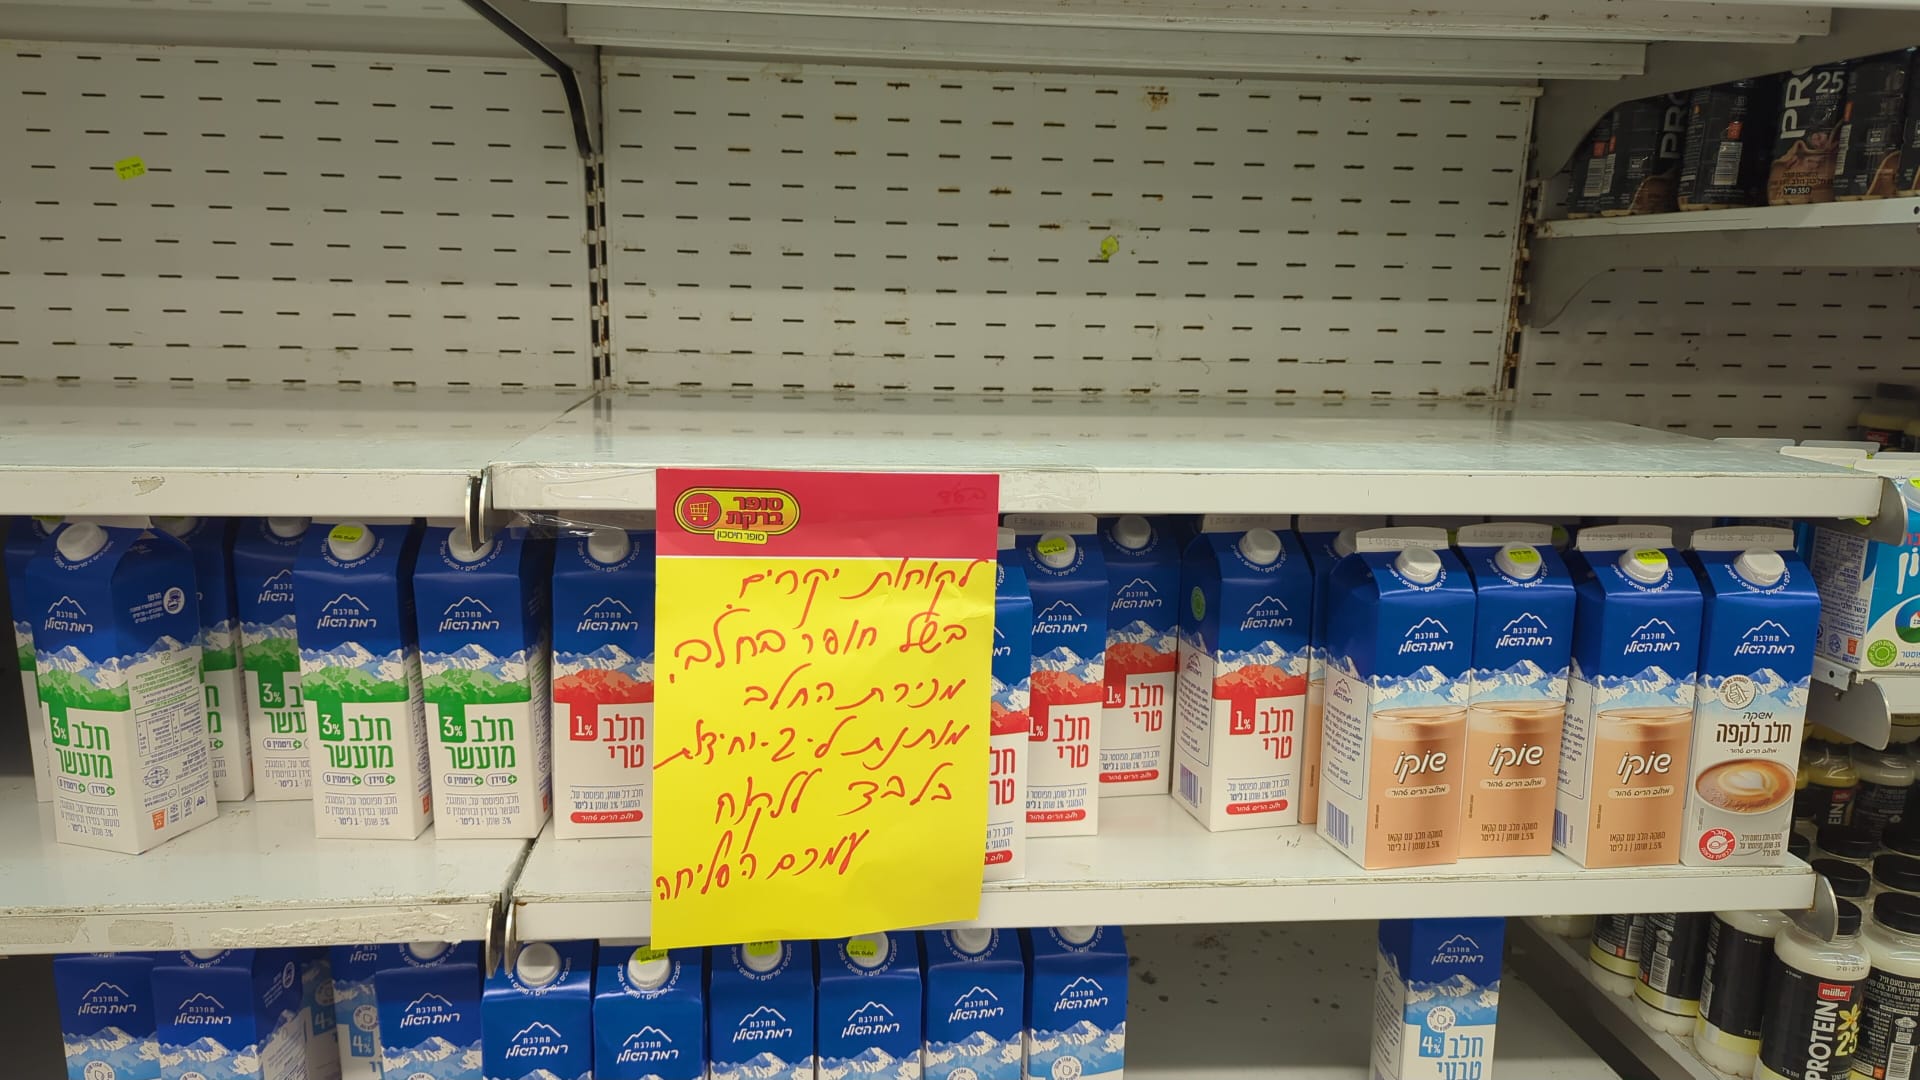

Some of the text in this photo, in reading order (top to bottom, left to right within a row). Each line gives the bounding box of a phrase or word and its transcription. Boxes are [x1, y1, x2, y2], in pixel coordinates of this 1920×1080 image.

[1816, 71, 1844, 94] 25
[733, 497, 783, 511] סופר
[726, 511, 784, 530] ברקת
[744, 533, 765, 542] סופר
[839, 556, 989, 622] לקוחות
[349, 617, 377, 628] רמת
[472, 620, 500, 631] רמת
[611, 621, 639, 631] רמת
[900, 612, 967, 654] בשל
[1061, 623, 1088, 633] רמת
[801, 620, 877, 655] חוסר
[1428, 641, 1454, 652] רמת
[1525, 636, 1553, 646] רמת
[1654, 642, 1680, 653] רמת
[1766, 645, 1795, 655] רמת
[261, 683, 281, 703] 3%
[743, 663, 834, 710] החלב
[1106, 683, 1164, 708] 1% חלב
[321, 714, 392, 741] 3% חלב
[443, 715, 514, 742] 3% חלב
[575, 714, 645, 742] 1% חלב
[1053, 714, 1090, 742] חלב
[1134, 709, 1162, 732] טרי
[1235, 707, 1293, 735] 1% חלב
[1743, 712, 1773, 722] משקה
[51, 717, 111, 751] 3% חלב
[1717, 721, 1792, 747] חלב לקפה
[323, 744, 394, 768] מועשר
[445, 745, 516, 769] מועשר
[608, 744, 645, 768] טרי
[1057, 744, 1088, 768] טרי
[1263, 736, 1292, 759] טרי
[1488, 743, 1544, 776] שוקו
[55, 748, 113, 778] מועשר
[1393, 750, 1448, 784] שוקו
[1617, 751, 1673, 785] שוקו
[989, 778, 1015, 805] טר
[715, 762, 953, 854] בלבד ללקוח
[655, 830, 870, 900] עמכם הסליחה
[1083, 998, 1109, 1008] רמת
[1822, 987, 1847, 997] müller
[432, 1013, 461, 1024] רמת
[979, 1007, 1004, 1019] רמת
[764, 1029, 793, 1040] רמת
[873, 1023, 900, 1034] רמת
[539, 1044, 568, 1055] רמת
[649, 1050, 679, 1060] רמת
[1448, 1034, 1485, 1058] חלב
[1835, 1031, 1858, 1057] 25
